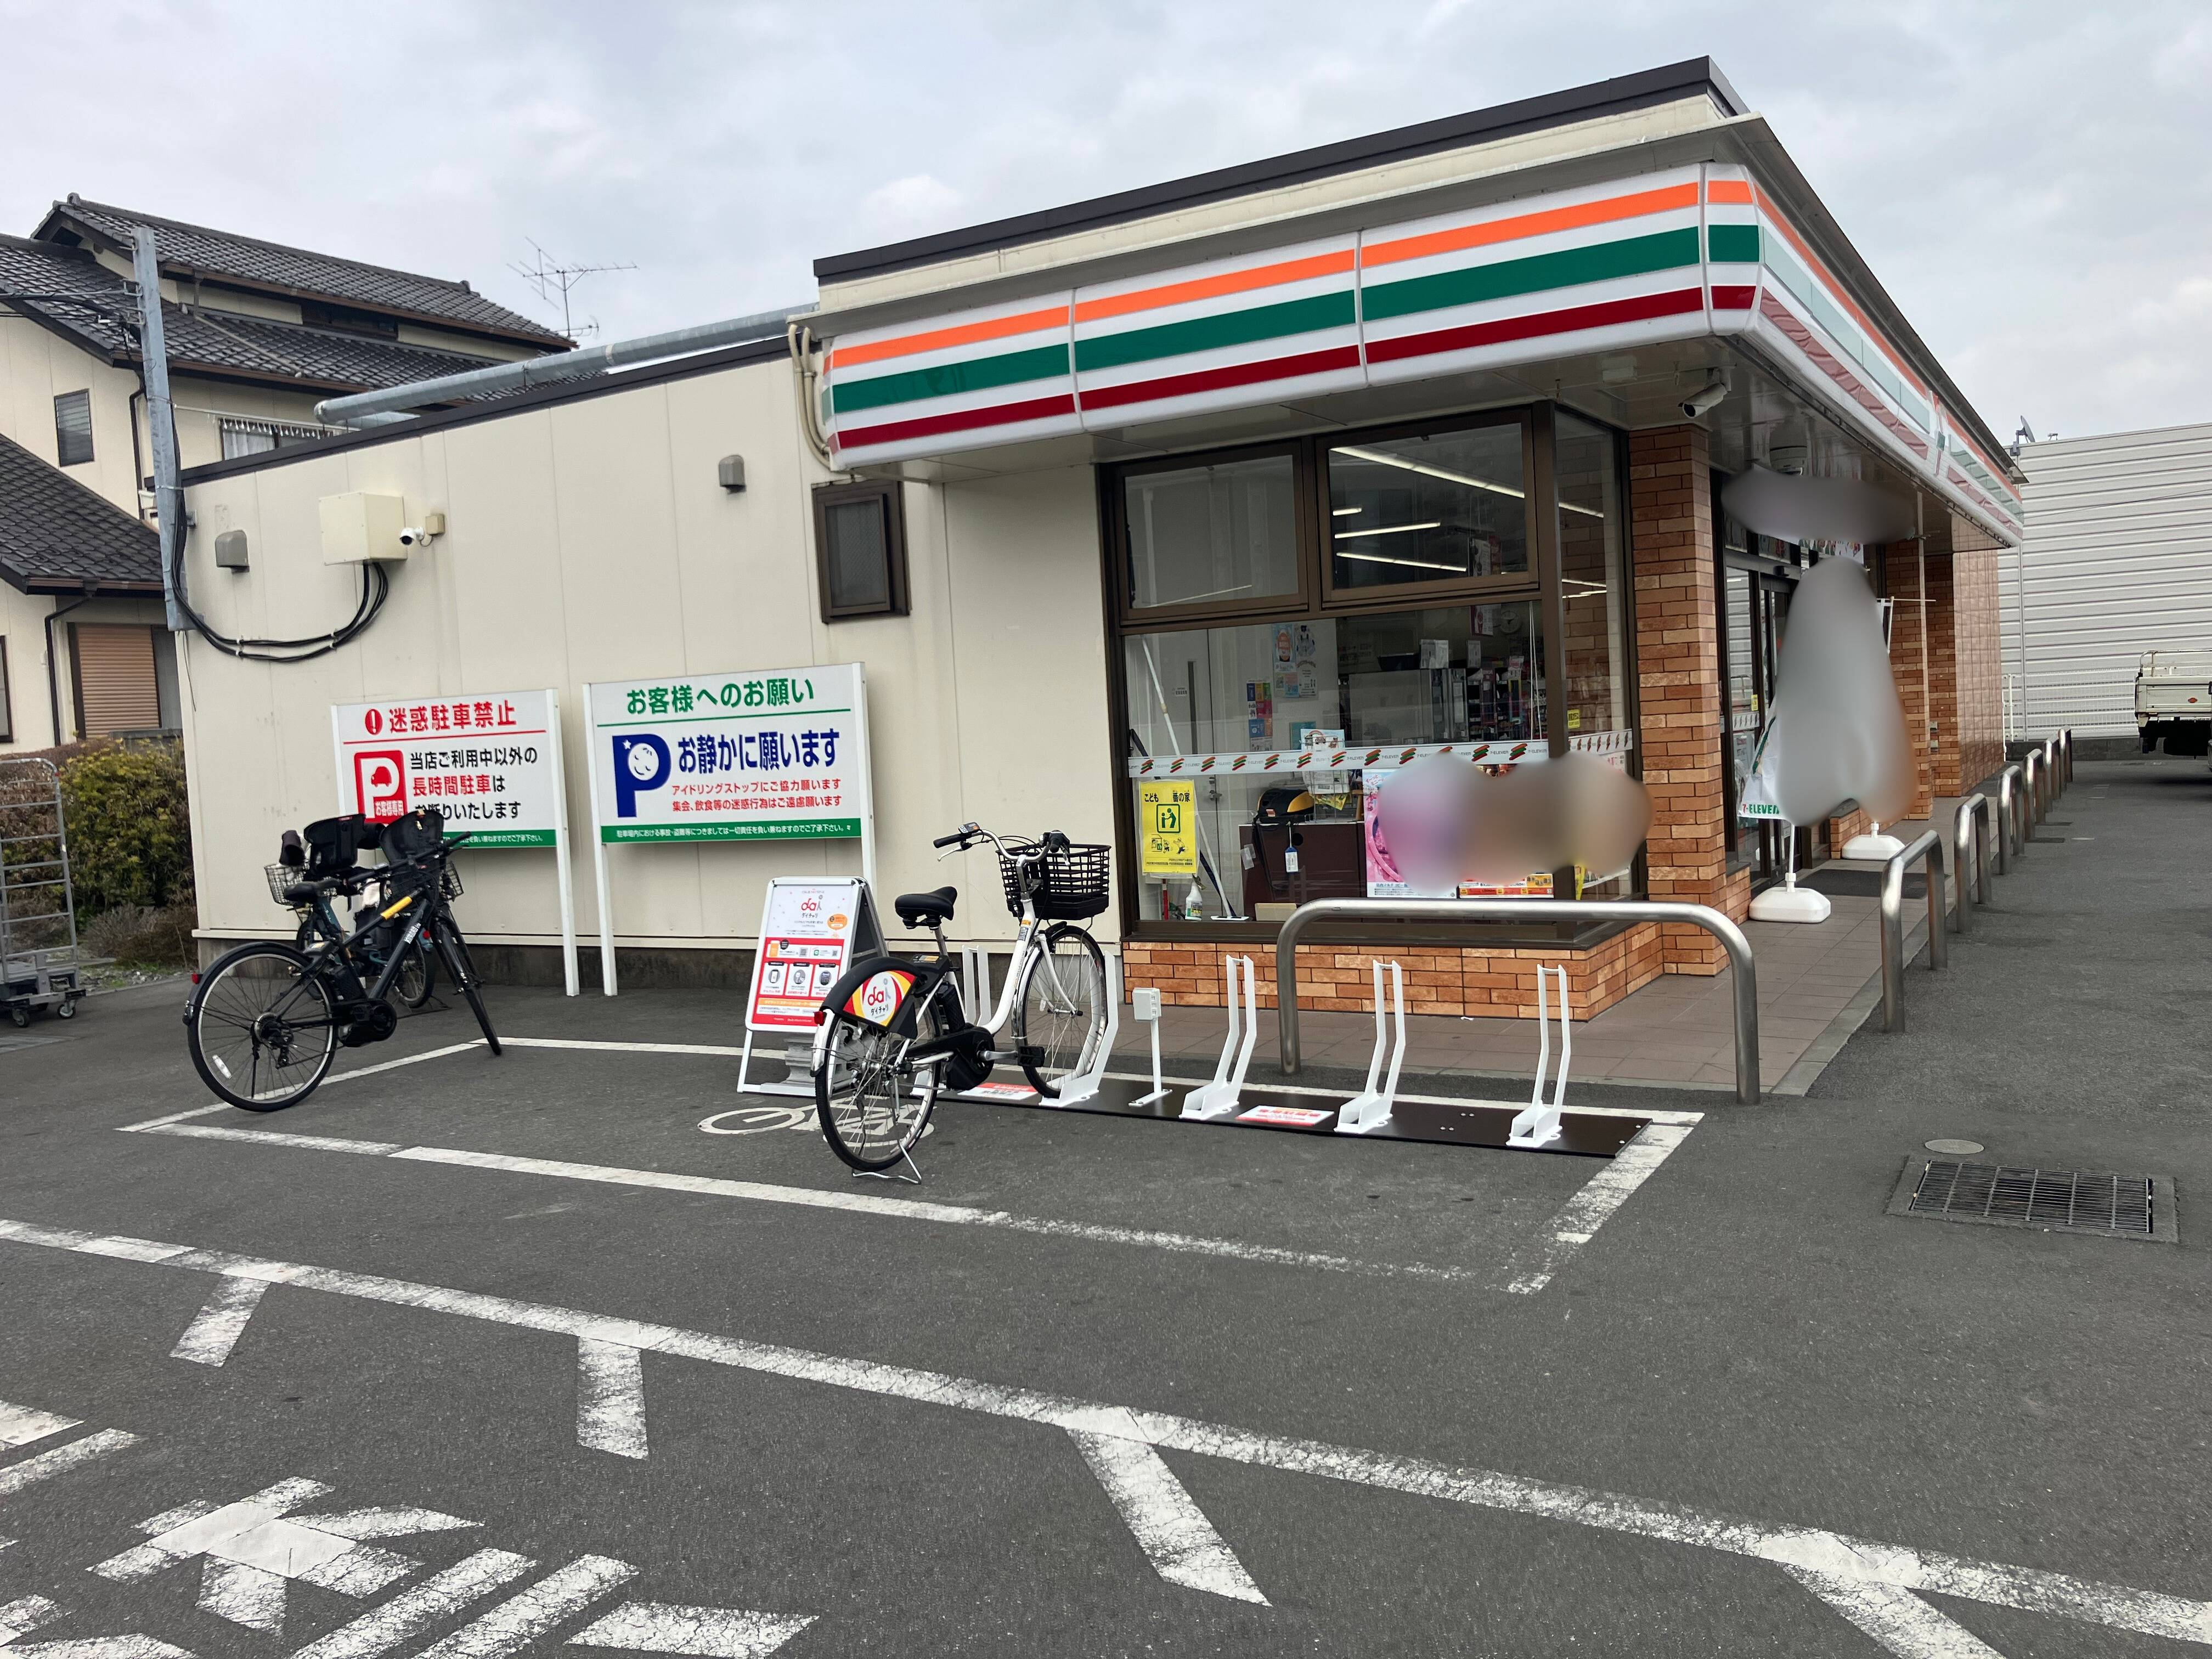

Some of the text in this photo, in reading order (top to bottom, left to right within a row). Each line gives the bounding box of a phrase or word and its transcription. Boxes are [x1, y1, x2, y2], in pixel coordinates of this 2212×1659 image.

[627, 678, 814, 715] お客様へのお願い
[388, 700, 517, 733] 迷惑駐車禁止
[410, 746, 538, 770] 当店ご利用中以外の
[678, 728, 840, 774] お静かに願います
[413, 774, 505, 797] 長時間駐車は
[672, 778, 841, 795] アイドリングストップにご協力願います
[672, 795, 842, 811] 集会、飲食等の迷惑行為はご遠慮願います
